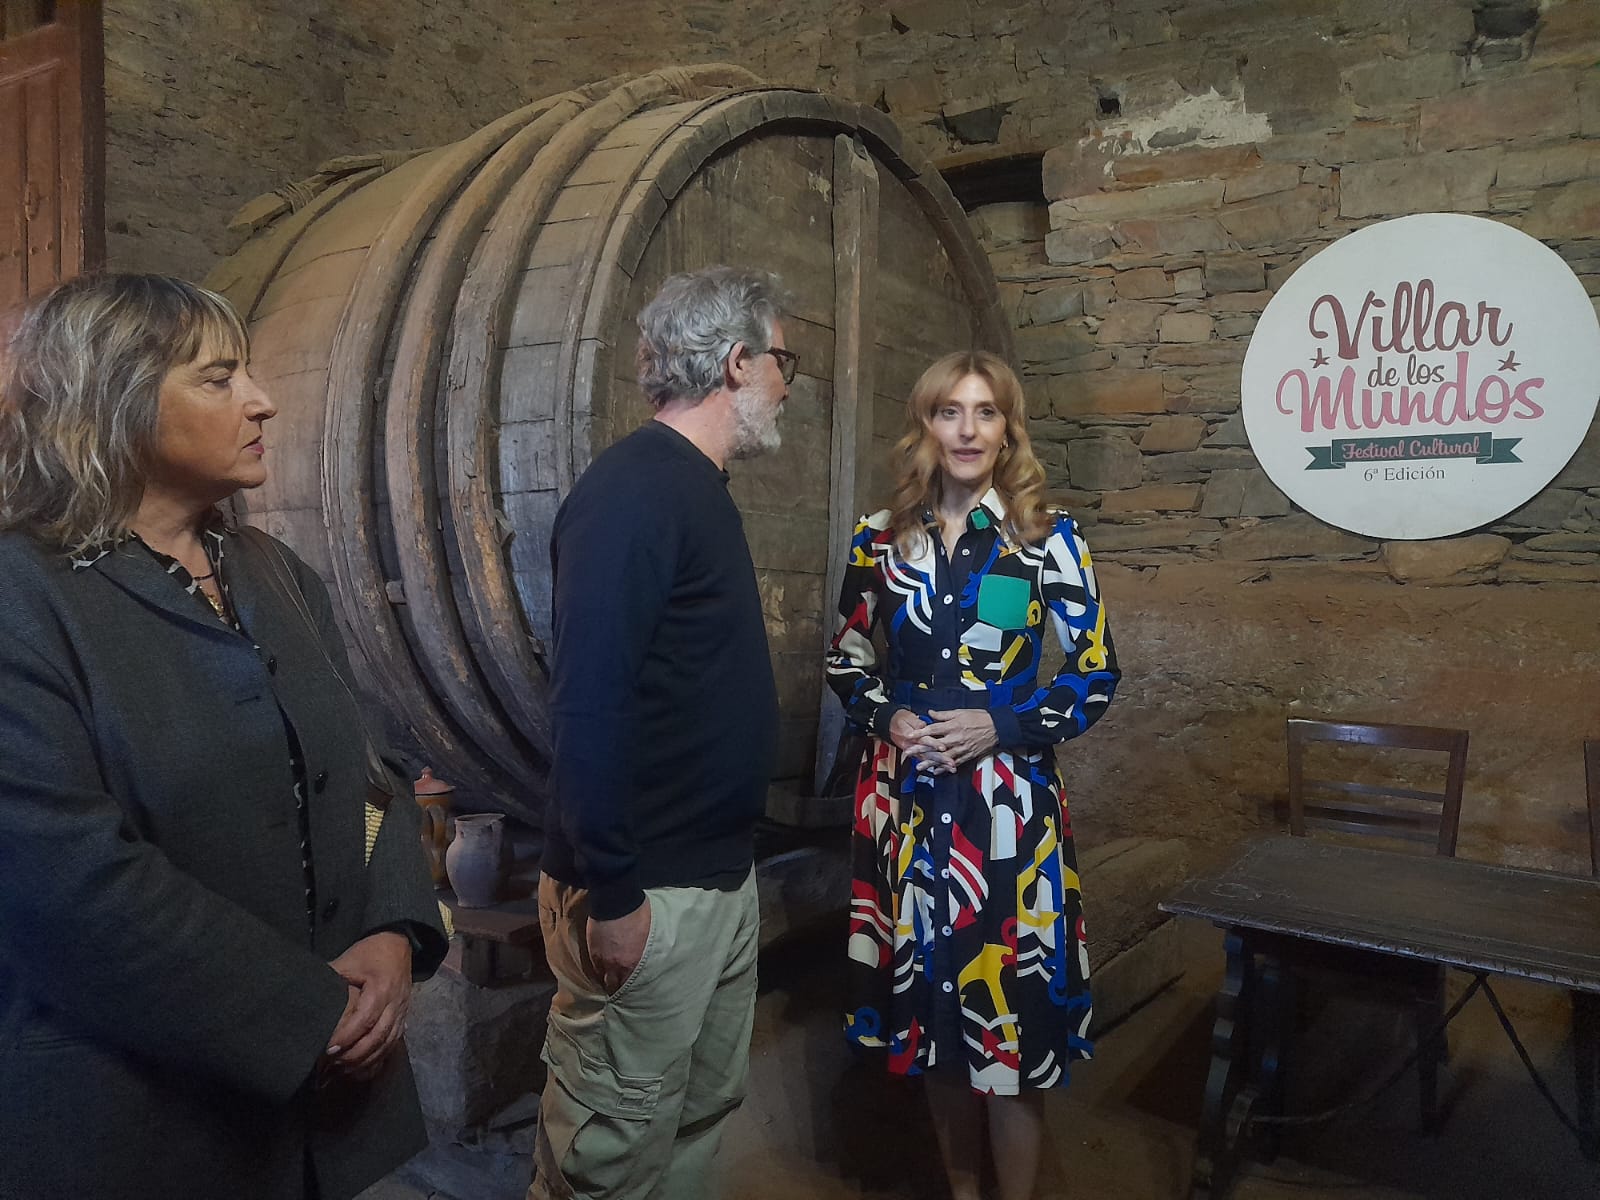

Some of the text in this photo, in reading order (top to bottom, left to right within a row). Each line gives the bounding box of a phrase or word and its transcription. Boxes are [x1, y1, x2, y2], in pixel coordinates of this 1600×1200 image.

[1308, 278, 1513, 360] Villar
[1367, 354, 1445, 388] de los
[1275, 351, 1545, 433] Mundos
[1342, 436, 1480, 460] Festival Cultural
[1363, 466, 1446, 482] 6ª Edición
